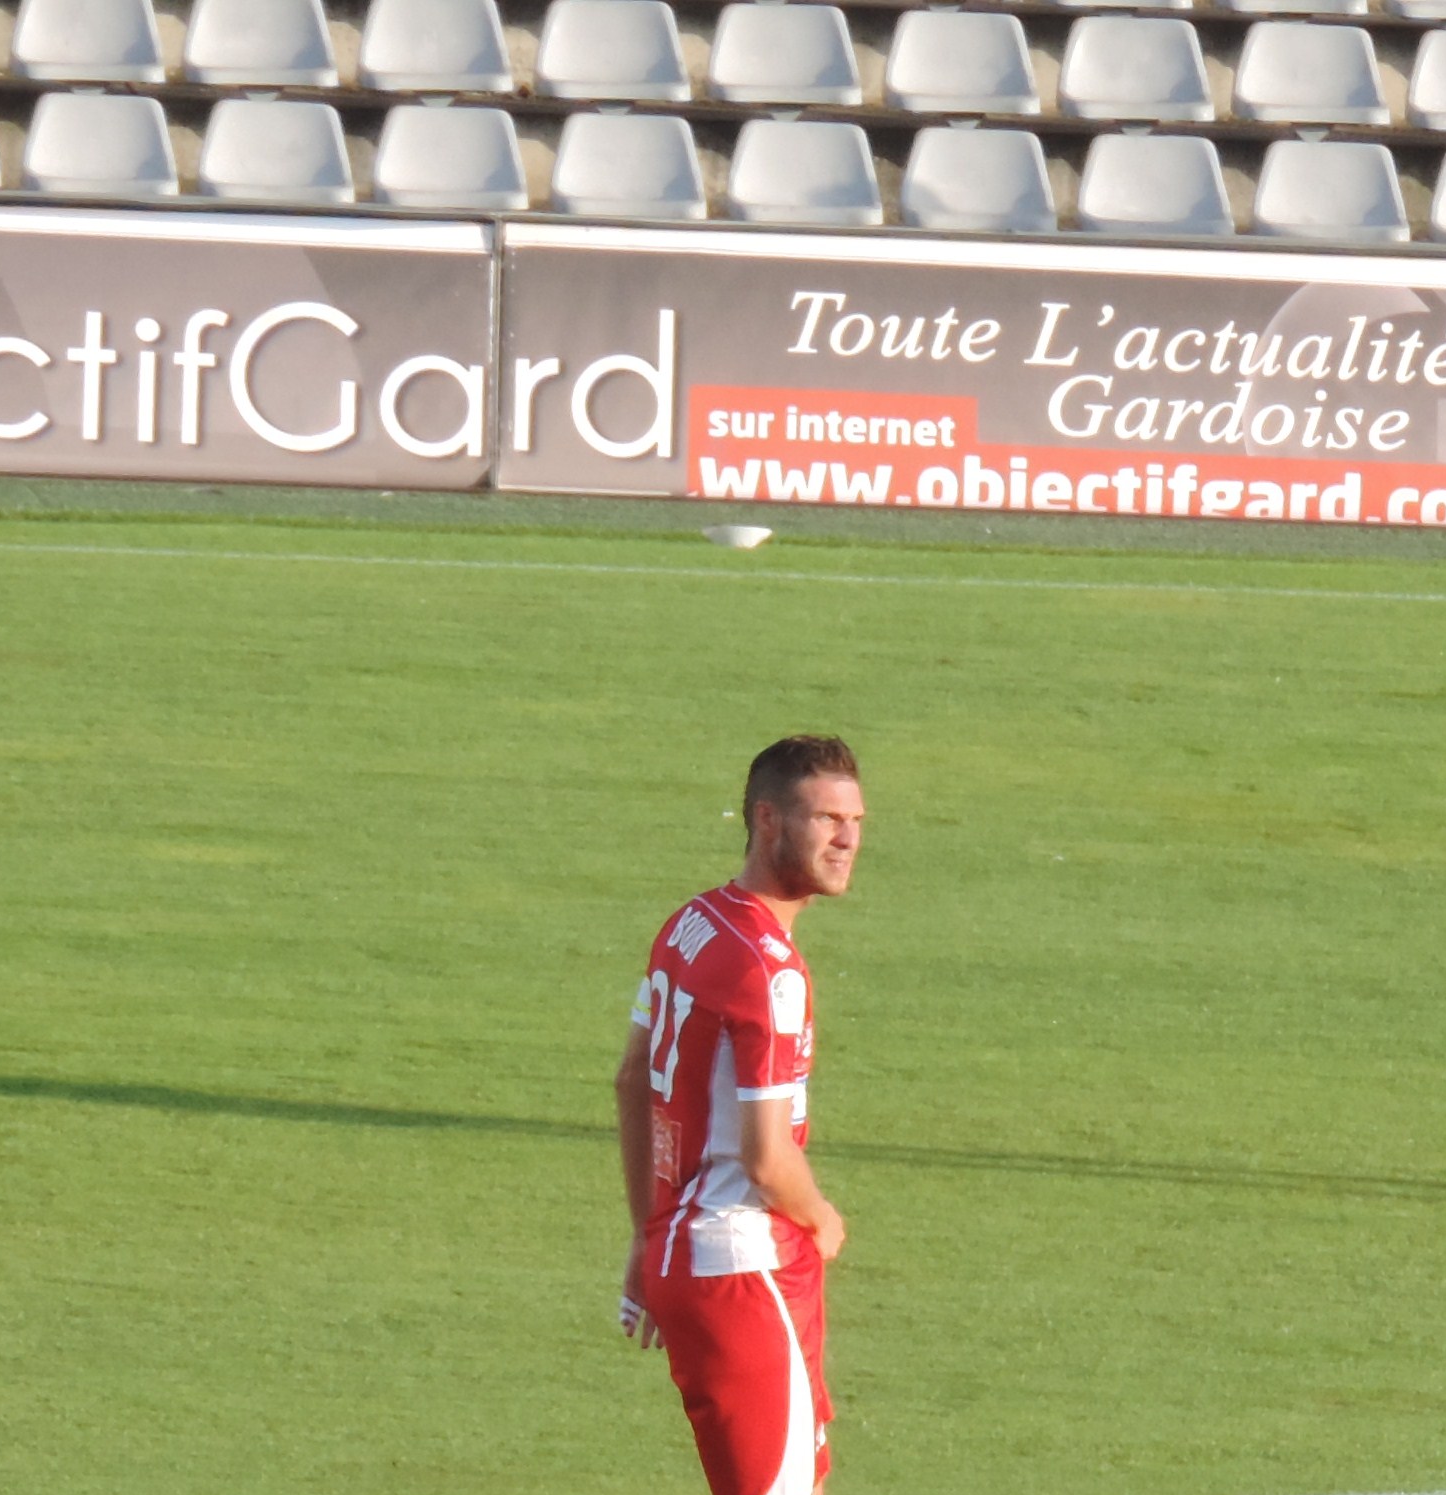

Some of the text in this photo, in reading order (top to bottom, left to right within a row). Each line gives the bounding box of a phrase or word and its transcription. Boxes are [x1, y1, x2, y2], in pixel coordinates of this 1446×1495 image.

[786, 290, 1001, 362] Toute
[708, 405, 956, 447] sur internet
[1047, 373, 1411, 452] Gardoise
[650, 969, 694, 1103] 27
